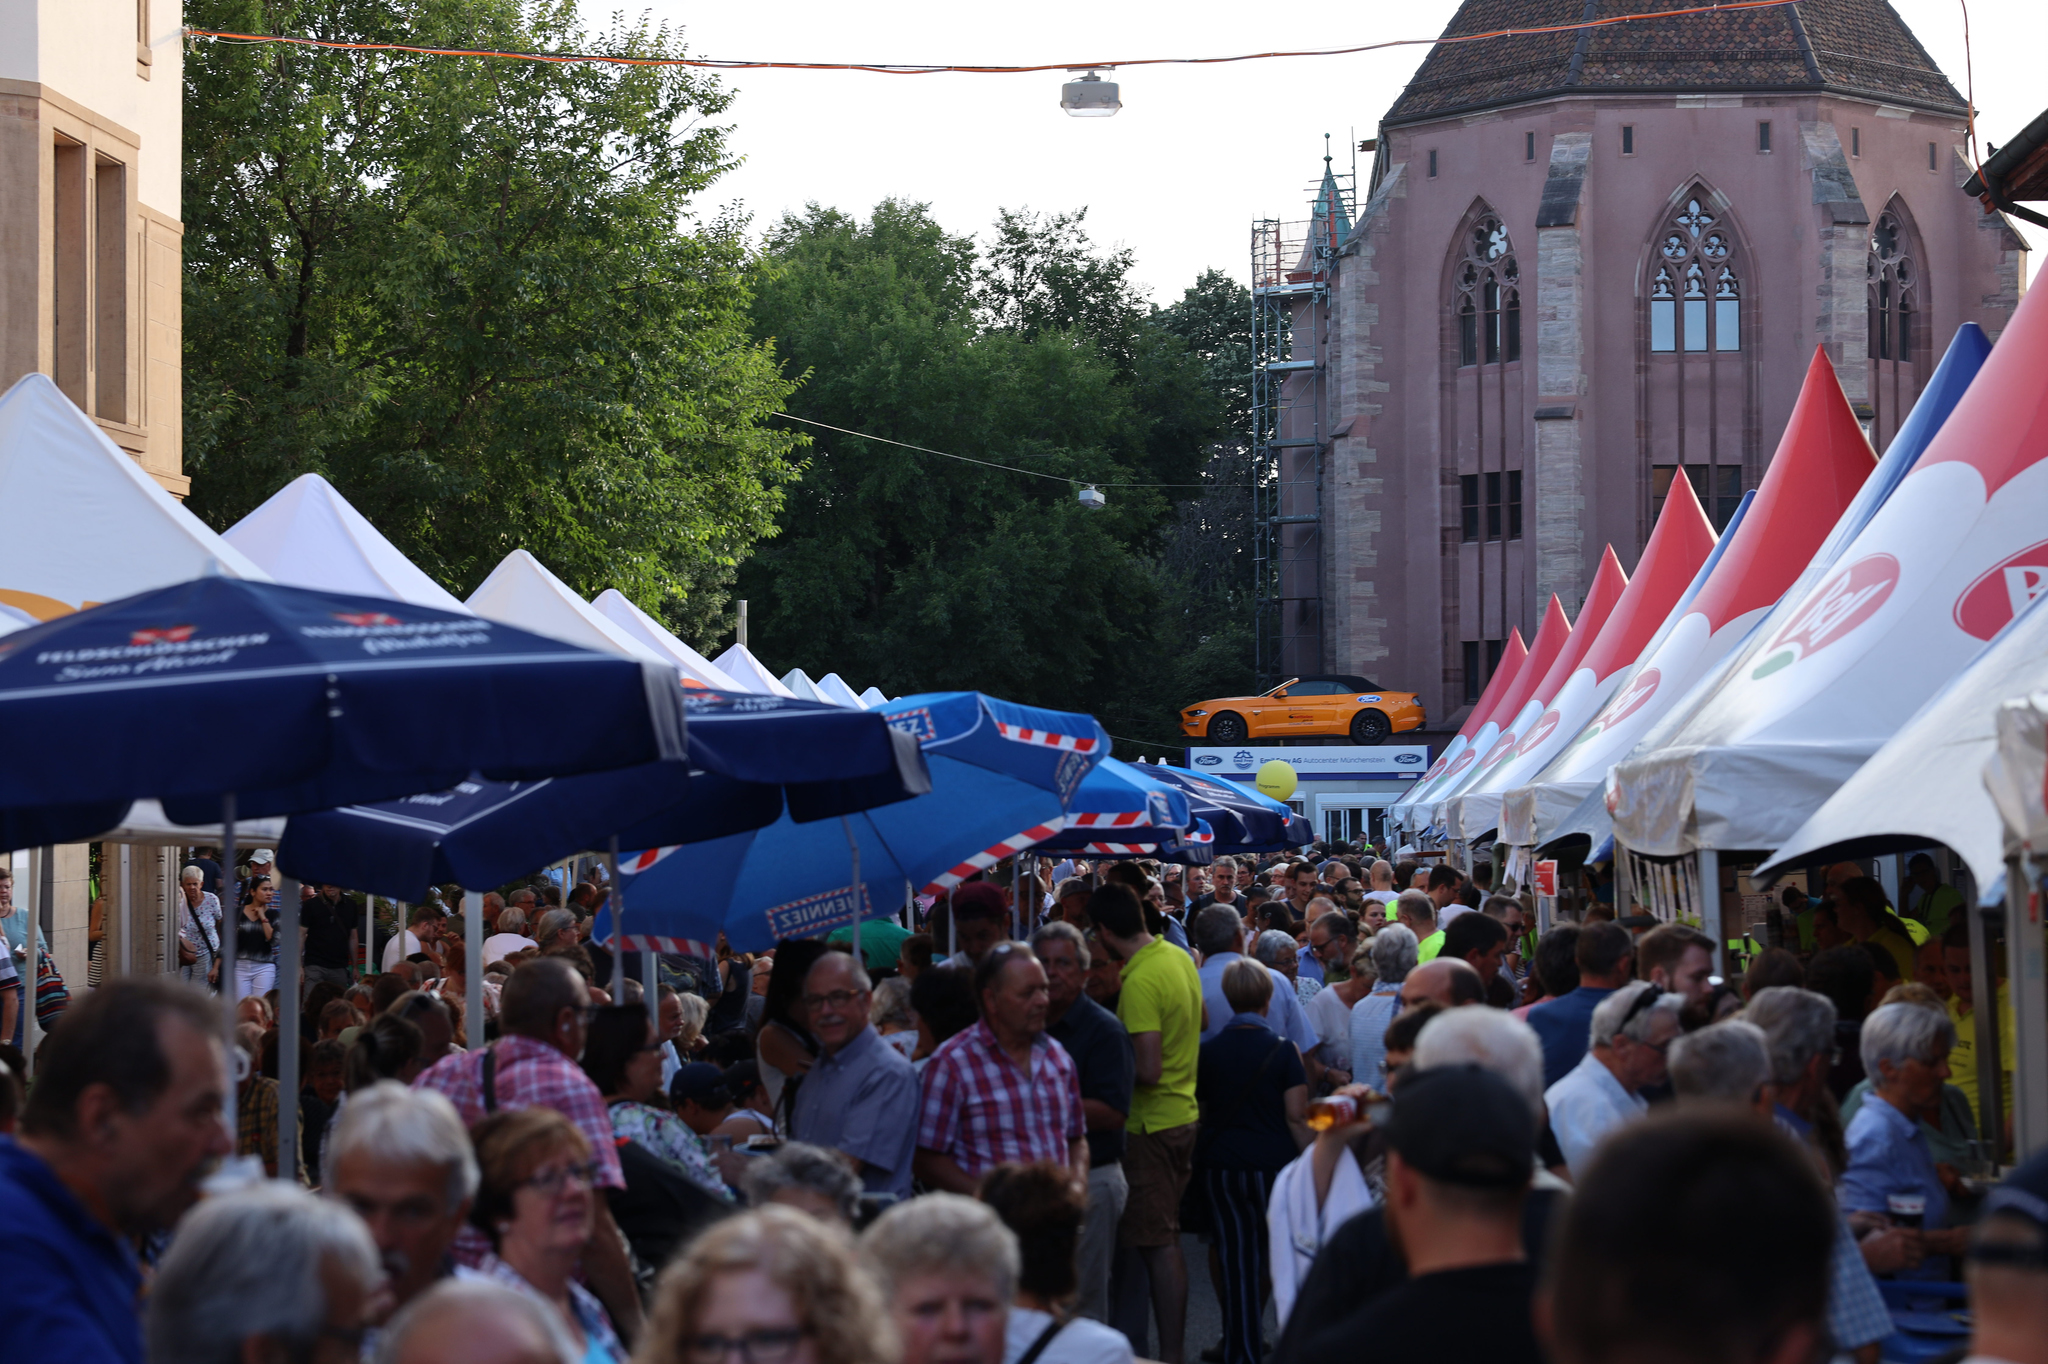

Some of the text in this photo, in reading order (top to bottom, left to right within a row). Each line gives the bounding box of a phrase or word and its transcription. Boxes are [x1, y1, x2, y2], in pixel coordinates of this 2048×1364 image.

[1198, 755, 1219, 765] Ford
[1341, 756, 1386, 764] Münchenstein
[1397, 754, 1419, 763] Ford
